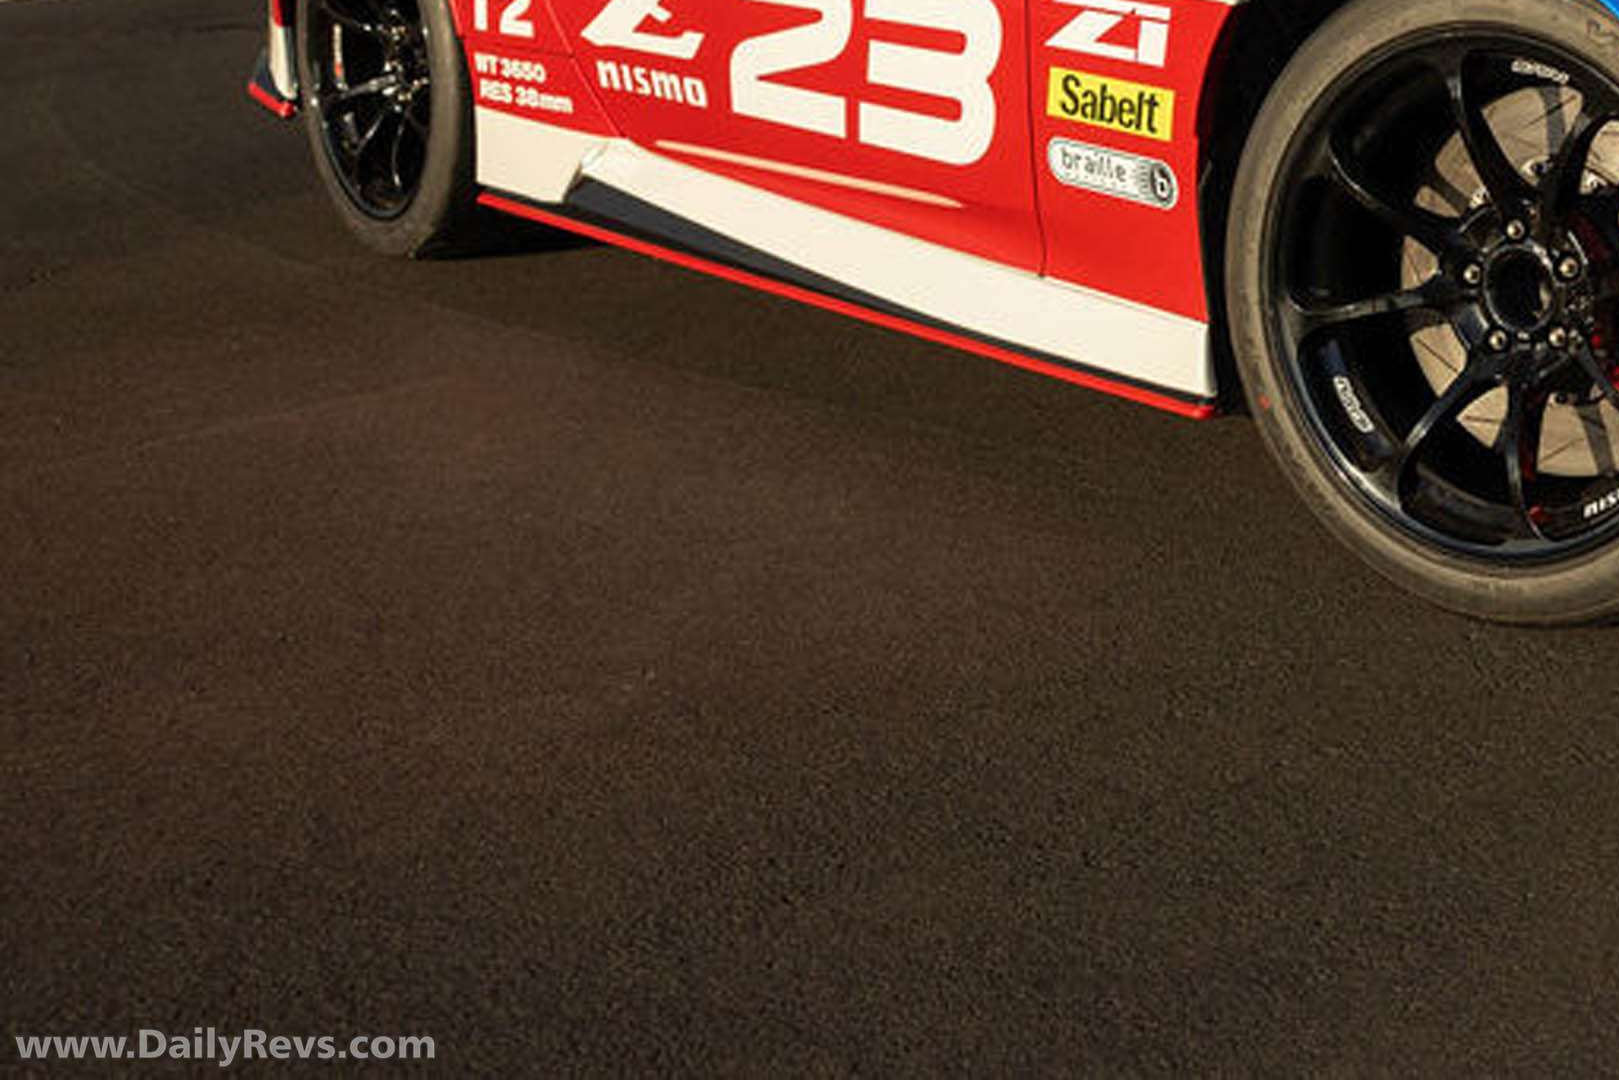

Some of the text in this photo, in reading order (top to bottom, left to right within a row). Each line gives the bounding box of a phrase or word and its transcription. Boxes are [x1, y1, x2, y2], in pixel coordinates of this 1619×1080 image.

[596, 60, 708, 108] nismo
[1060, 73, 1160, 134] Sabelt
[1060, 147, 1127, 184] braille
